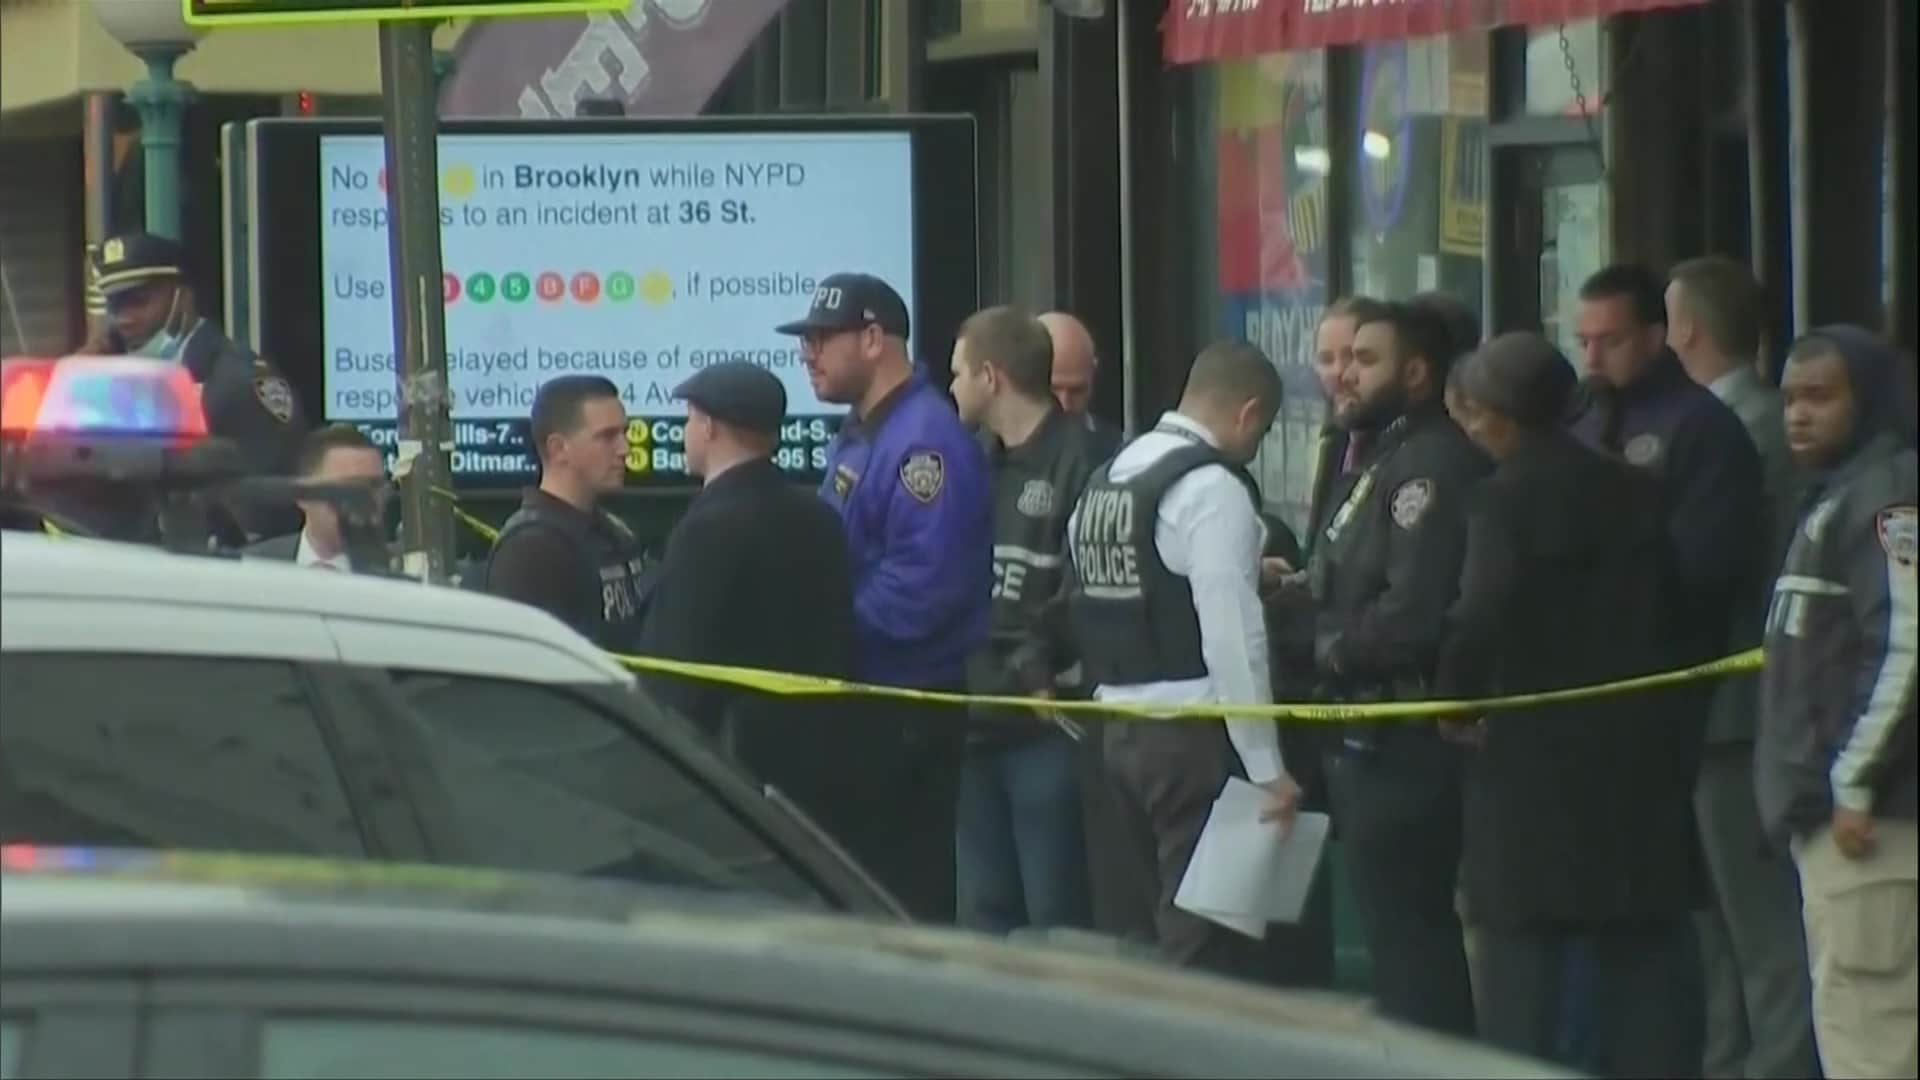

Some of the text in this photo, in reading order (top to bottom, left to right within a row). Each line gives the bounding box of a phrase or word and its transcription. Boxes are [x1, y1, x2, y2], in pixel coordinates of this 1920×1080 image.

[332, 163, 805, 193] No in Brooklyn while NYPD
[463, 204, 487, 225] to
[496, 206, 527, 225] an
[537, 201, 638, 225] incident
[647, 202, 671, 224] at
[679, 200, 711, 224] 36
[721, 200, 756, 224] St.
[334, 275, 385, 299] Use
[688, 273, 701, 295] if
[710, 272, 816, 300] possible
[335, 347, 395, 372] Buse
[449, 347, 529, 375] elayed
[538, 347, 648, 369] because
[657, 346, 681, 369] of
[622, 384, 635, 405] 4
[645, 382, 681, 405] Av
[652, 421, 684, 442] Co
[811, 447, 828, 469] S
[1079, 489, 1133, 543] NYPD
[1078, 544, 1140, 585] POLICE
